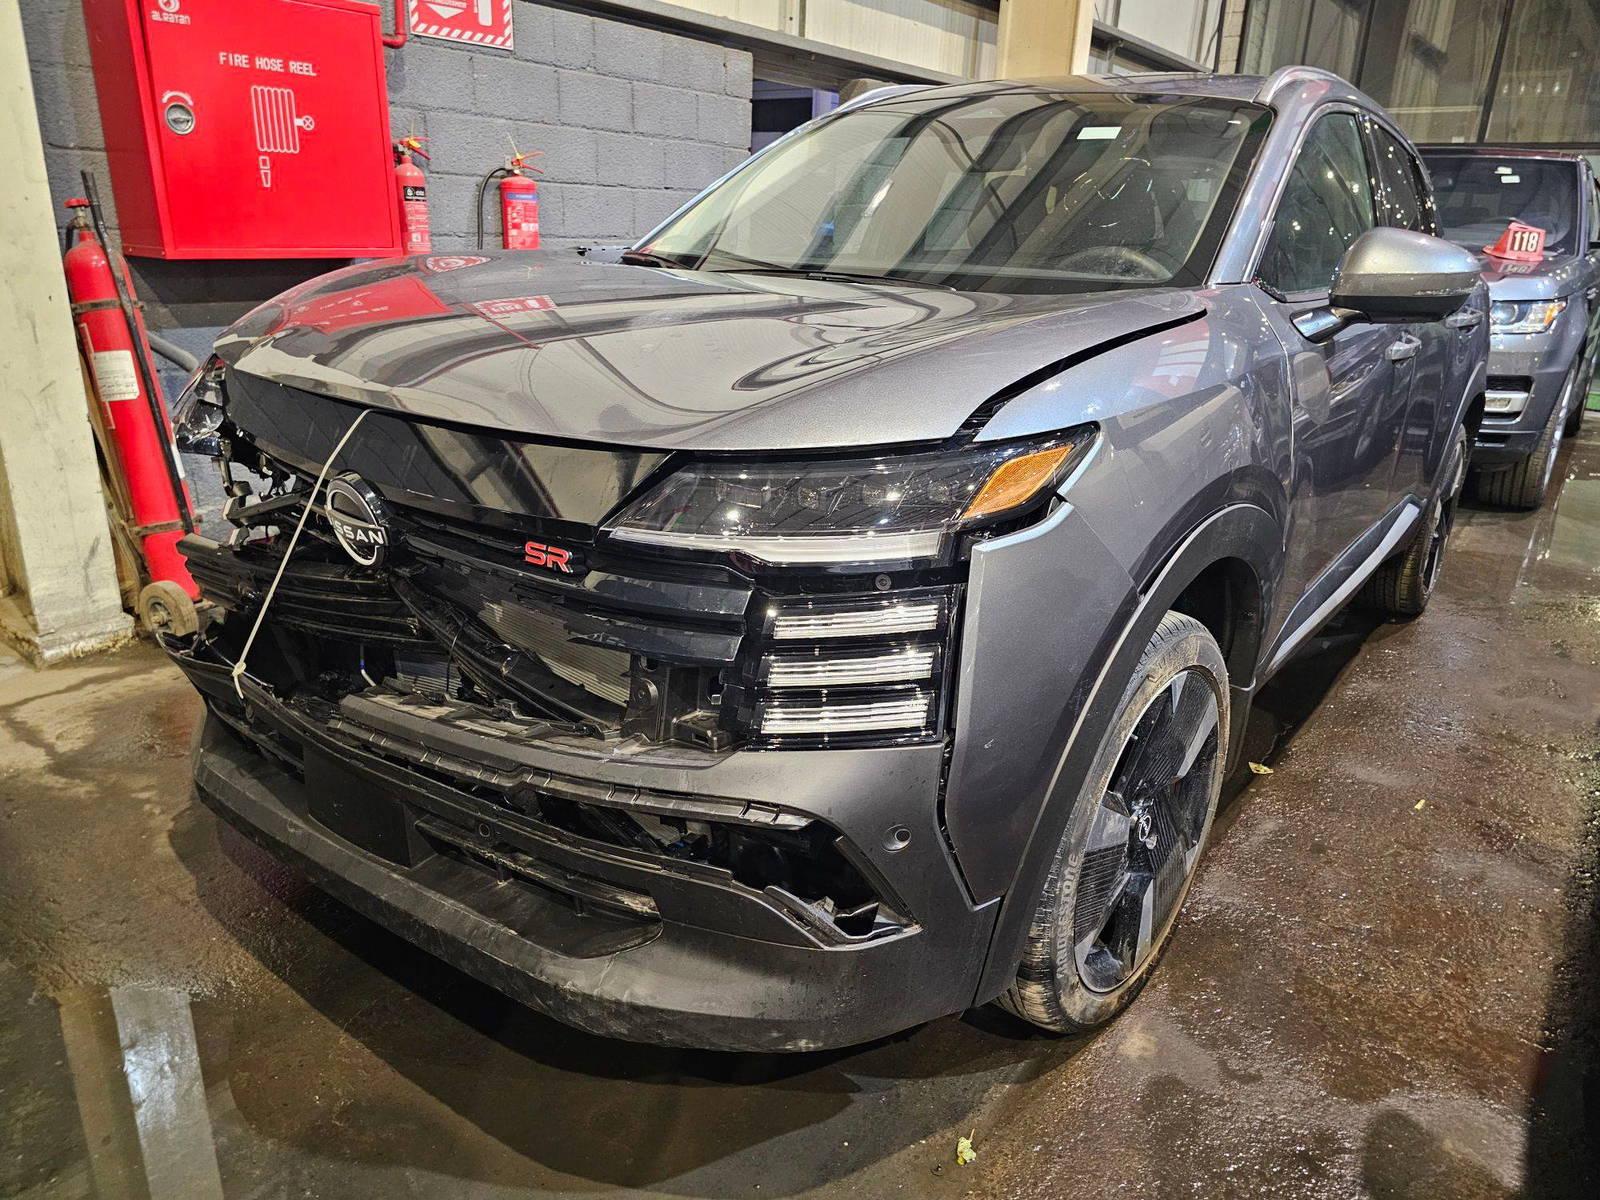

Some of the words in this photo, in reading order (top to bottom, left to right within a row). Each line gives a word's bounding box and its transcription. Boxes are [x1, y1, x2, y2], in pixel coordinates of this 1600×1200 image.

[219, 52, 250, 68] FIRE
[255, 56, 285, 72] HOSE
[288, 60, 317, 76] REEL
[1513, 230, 1539, 252] 118
[525, 540, 573, 573] SR
